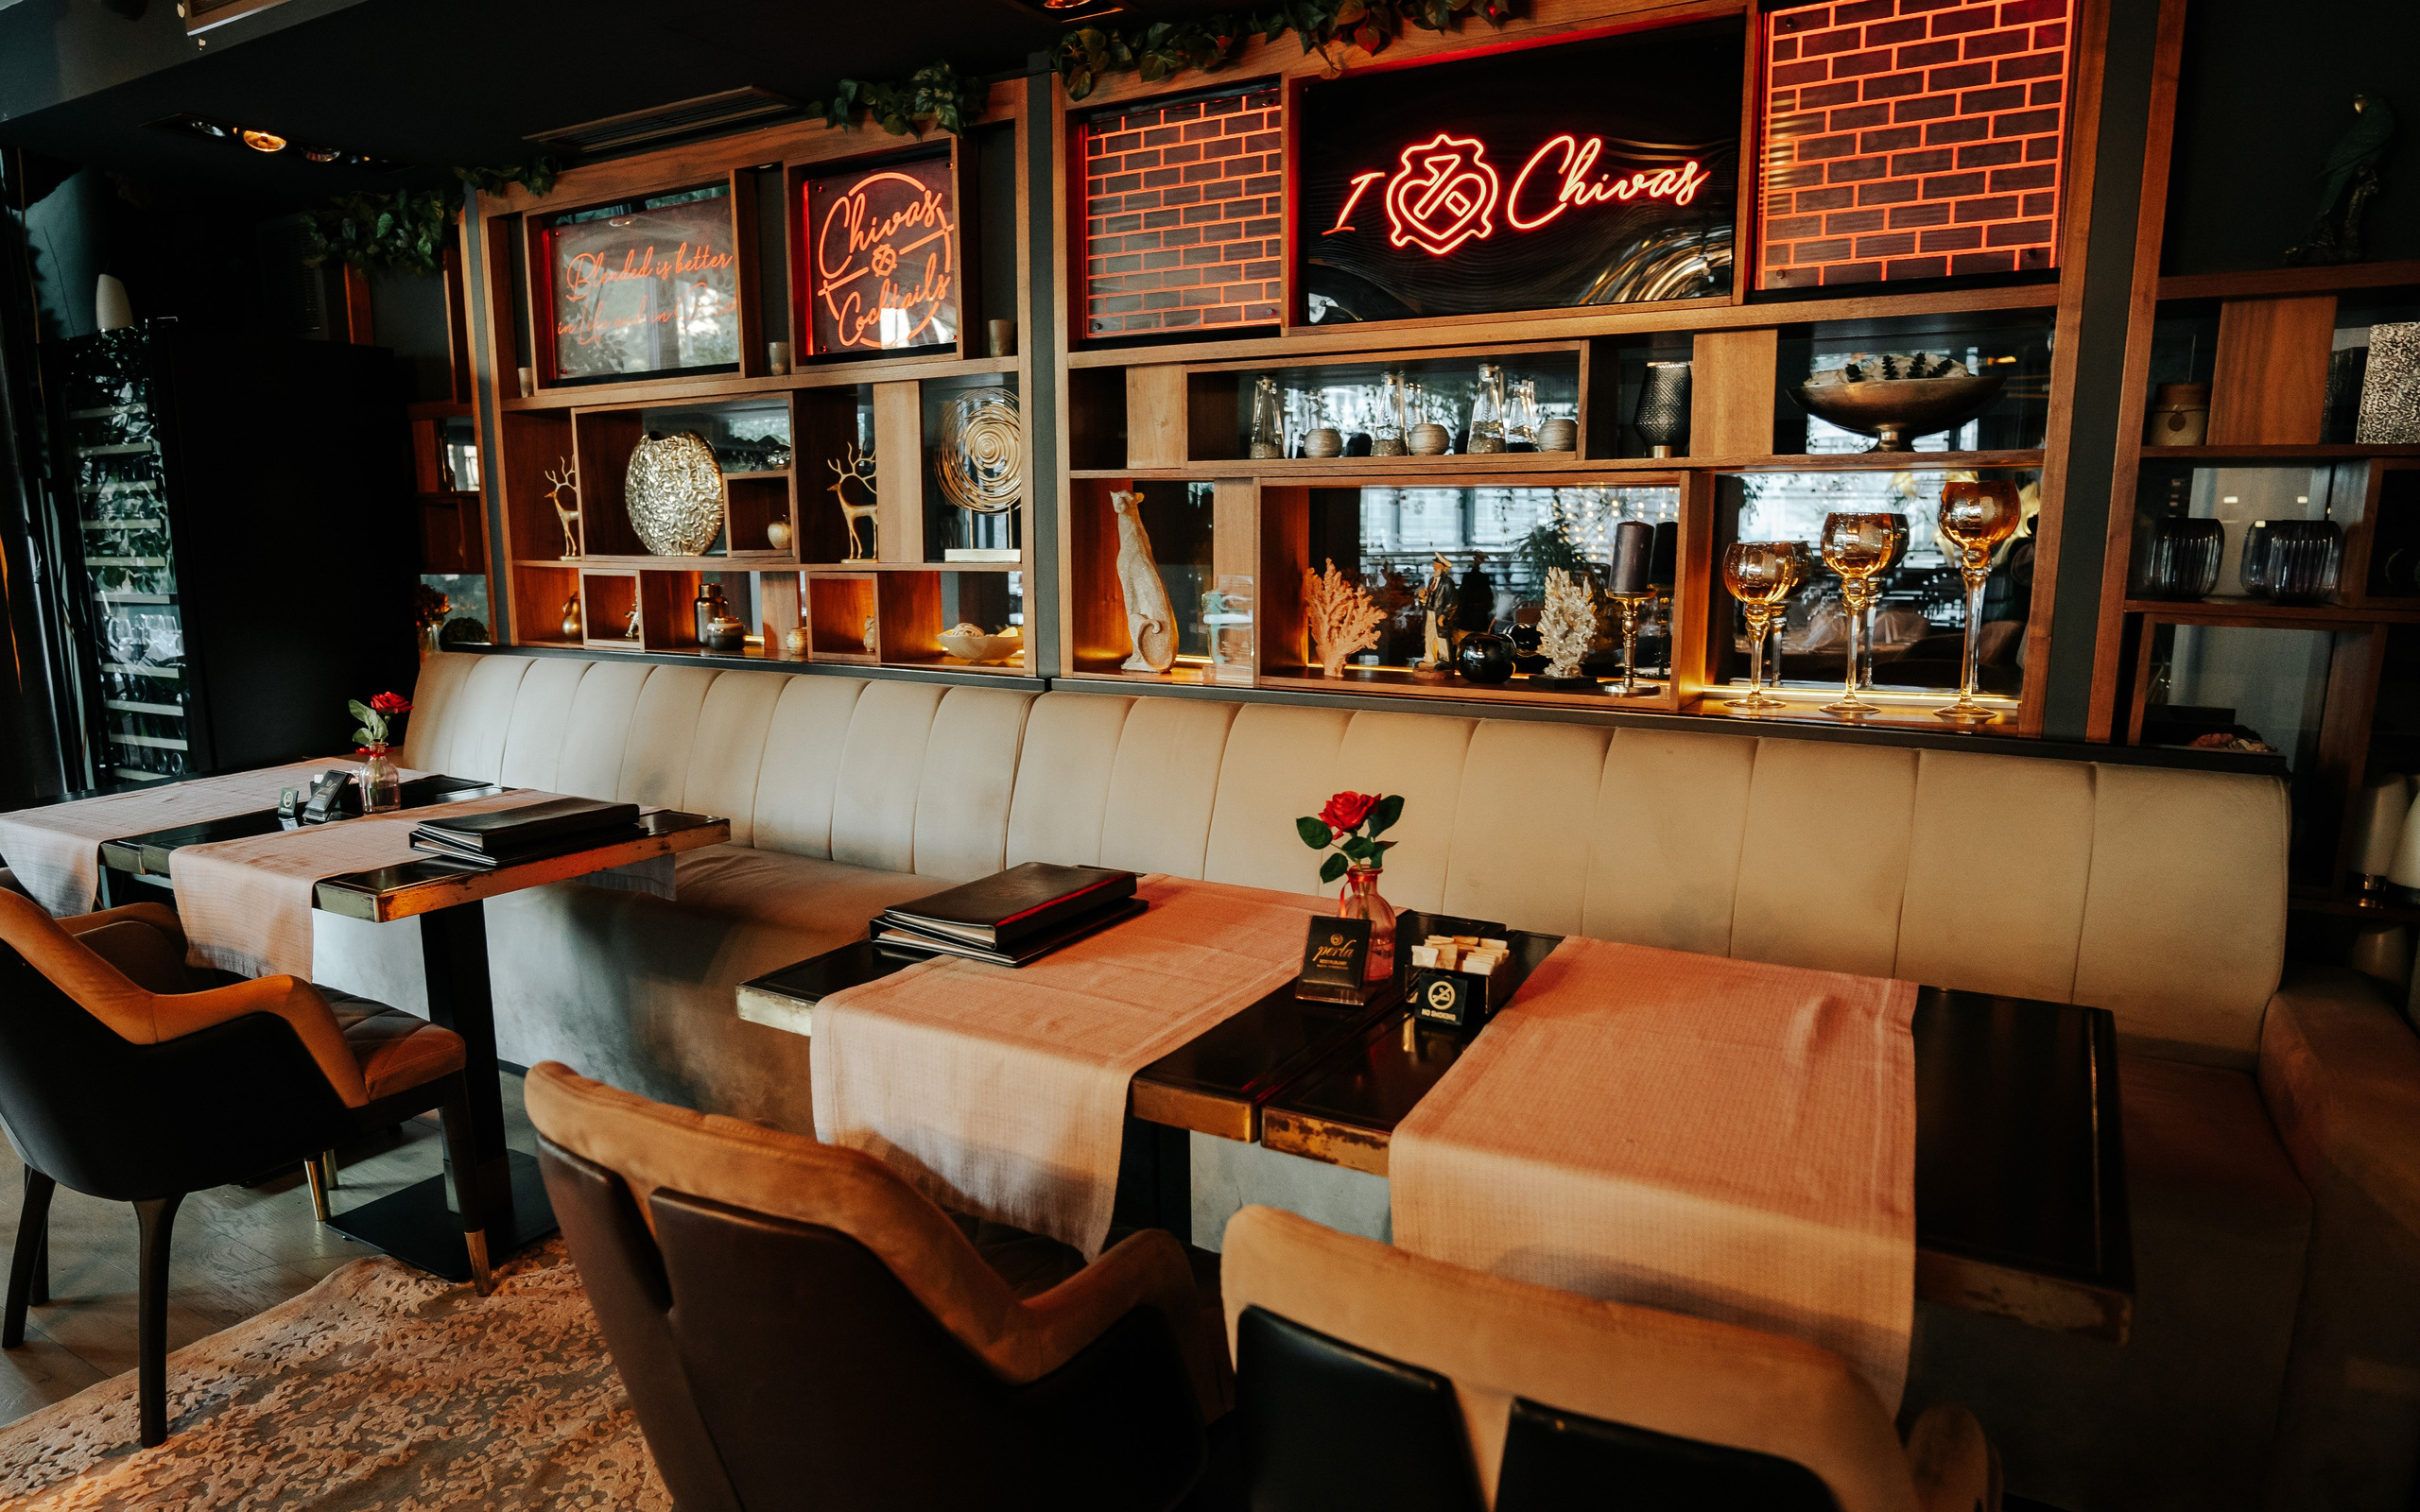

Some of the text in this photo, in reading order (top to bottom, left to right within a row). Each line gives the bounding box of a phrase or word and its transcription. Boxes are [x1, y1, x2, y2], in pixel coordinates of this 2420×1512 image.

[1322, 135, 1712, 235] I Chivas
[565, 241, 734, 302] Blended is better
[819, 190, 942, 279] Chivas
[557, 320, 577, 335] in
[614, 295, 648, 328] and
[650, 310, 674, 326] in
[838, 252, 951, 346] Cocktails
[1312, 939, 1357, 962] perla
